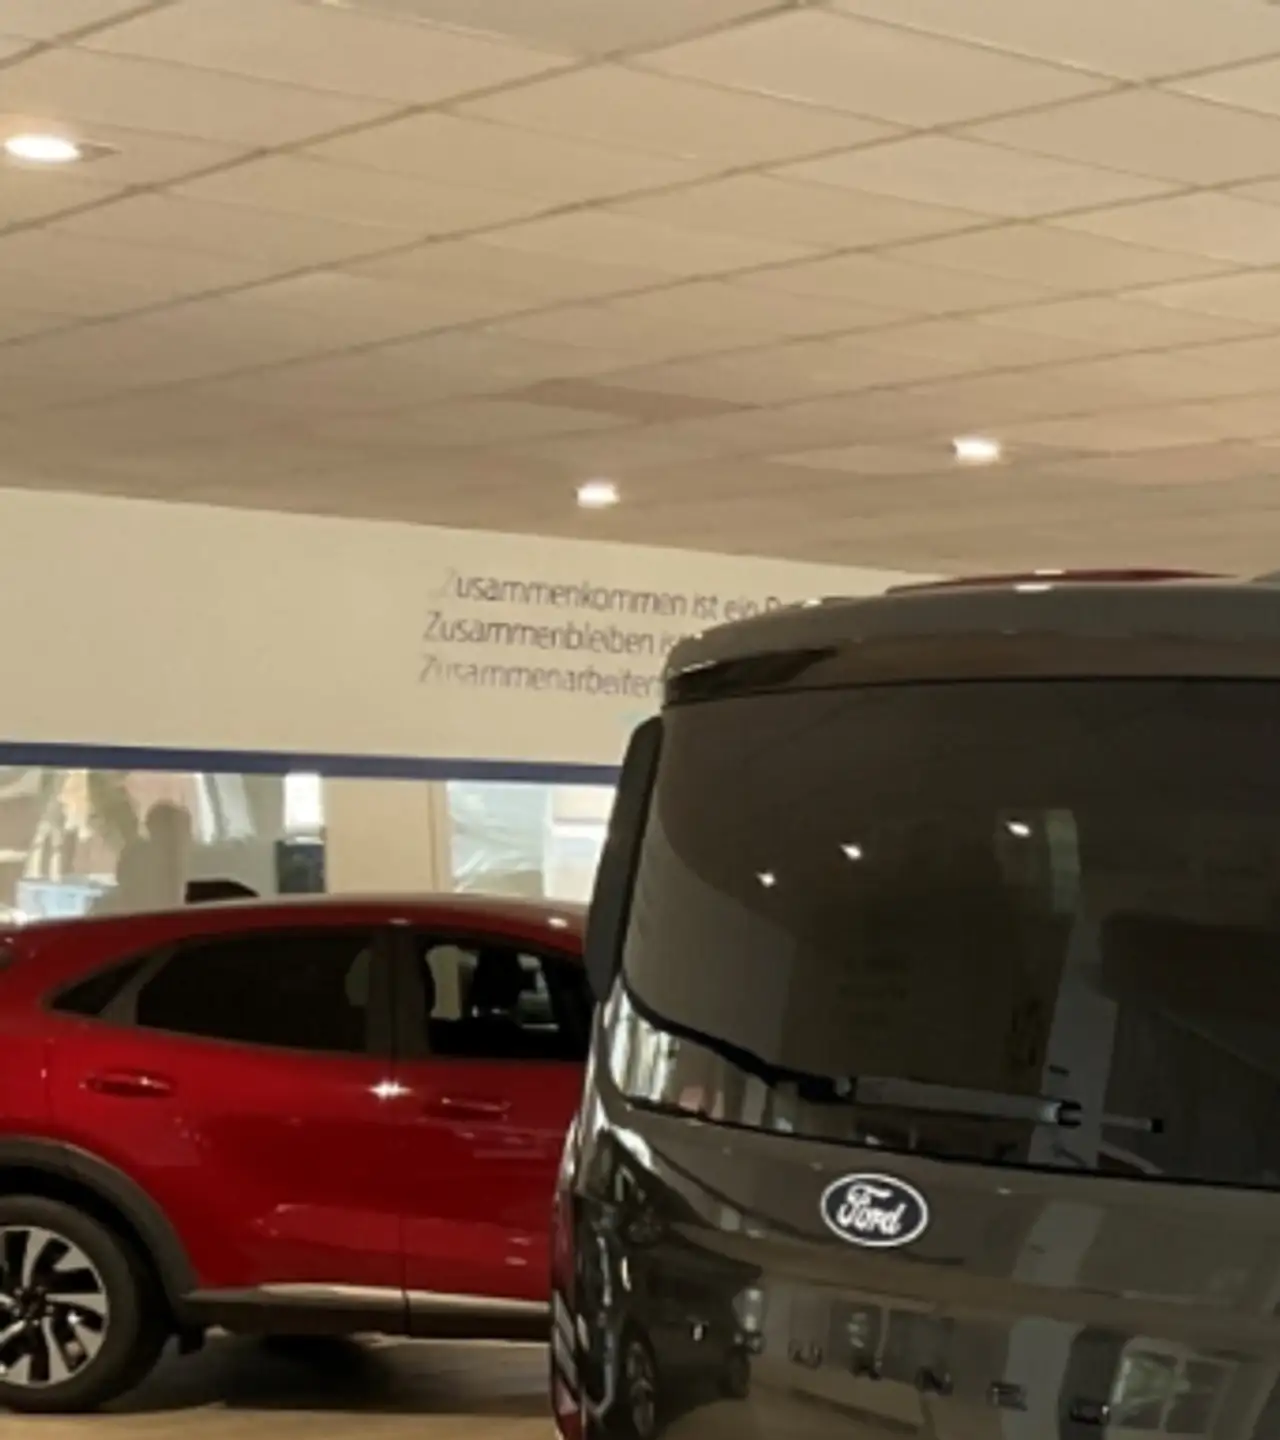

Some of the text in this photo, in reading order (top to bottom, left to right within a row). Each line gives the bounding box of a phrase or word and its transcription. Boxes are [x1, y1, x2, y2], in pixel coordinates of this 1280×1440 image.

[428, 565, 688, 618] Zusammenkommen
[421, 605, 654, 657] Zusammenbleiben
[836, 1181, 907, 1236] Ford
